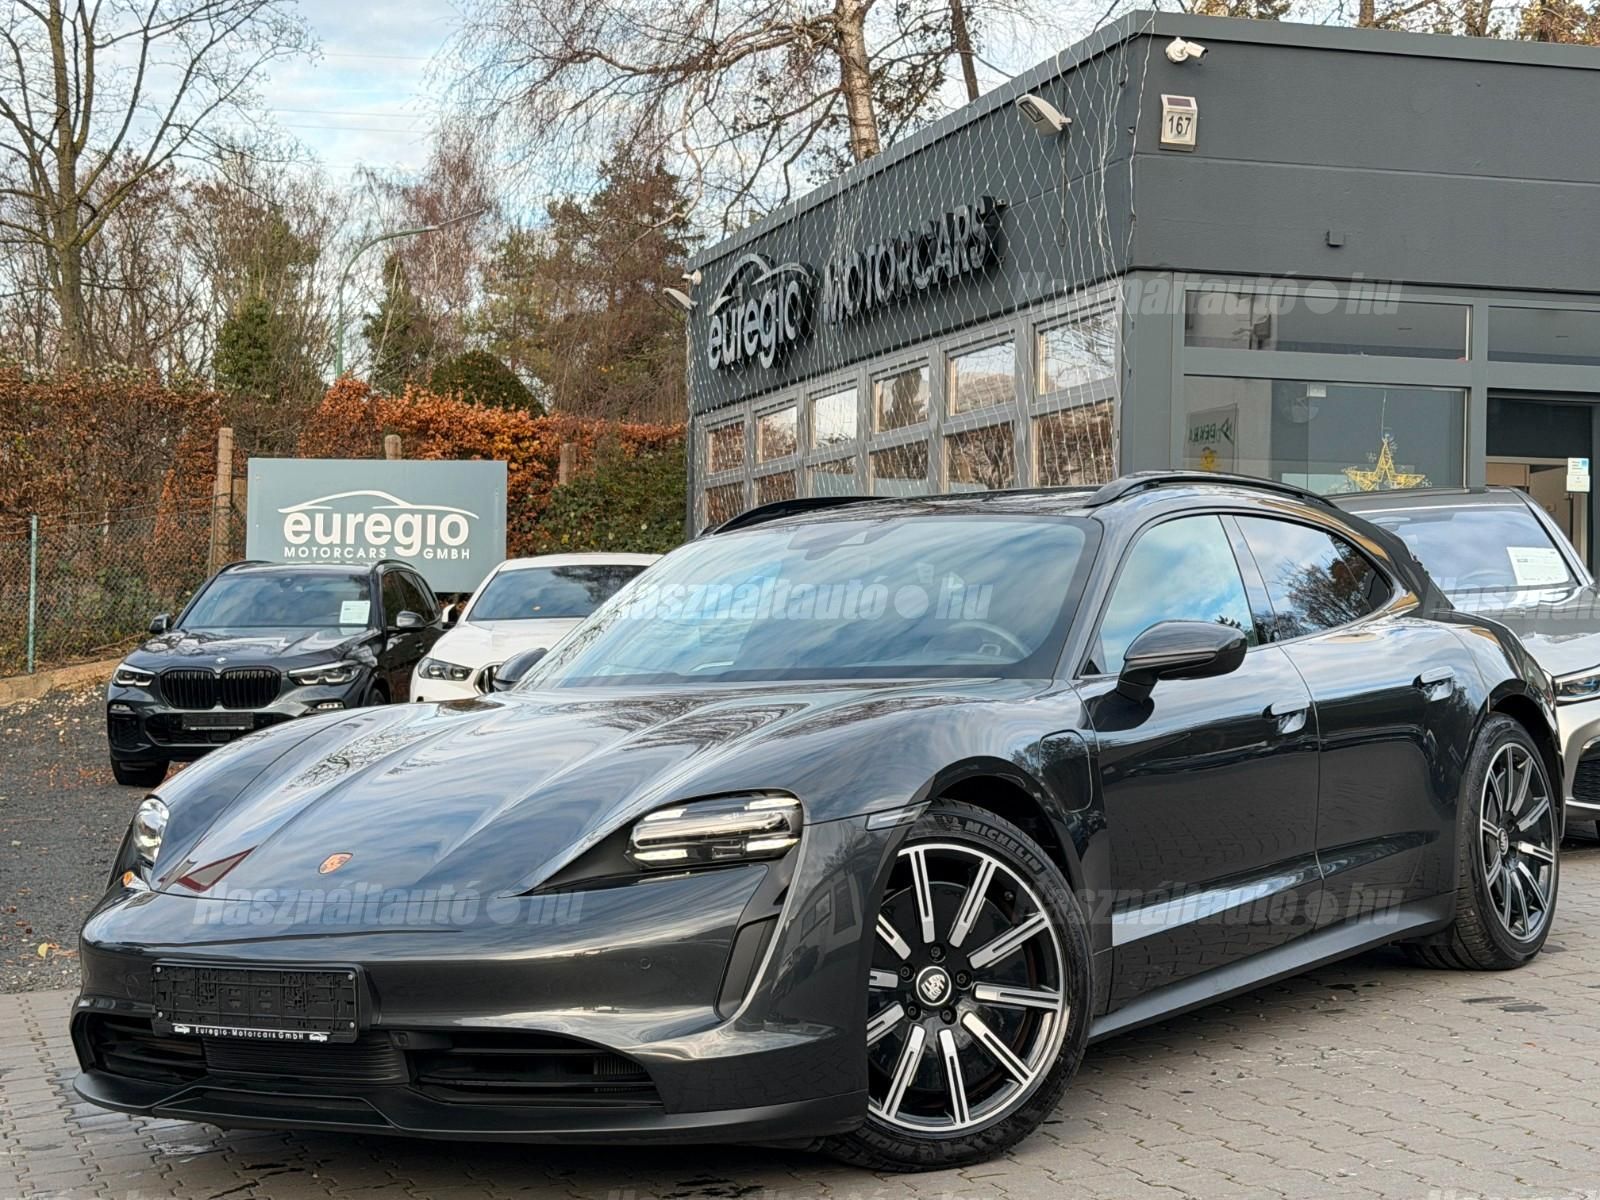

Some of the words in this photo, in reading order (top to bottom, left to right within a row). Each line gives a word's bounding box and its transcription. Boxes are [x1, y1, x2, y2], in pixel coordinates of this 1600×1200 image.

[1168, 116, 1192, 135] 167
[283, 512, 469, 557] euregio
[284, 546, 387, 559] MOTORCARS
[423, 548, 470, 559] GMBH
[964, 820, 1042, 873] MICHELIN
[278, 1031, 304, 1040] GmbH
